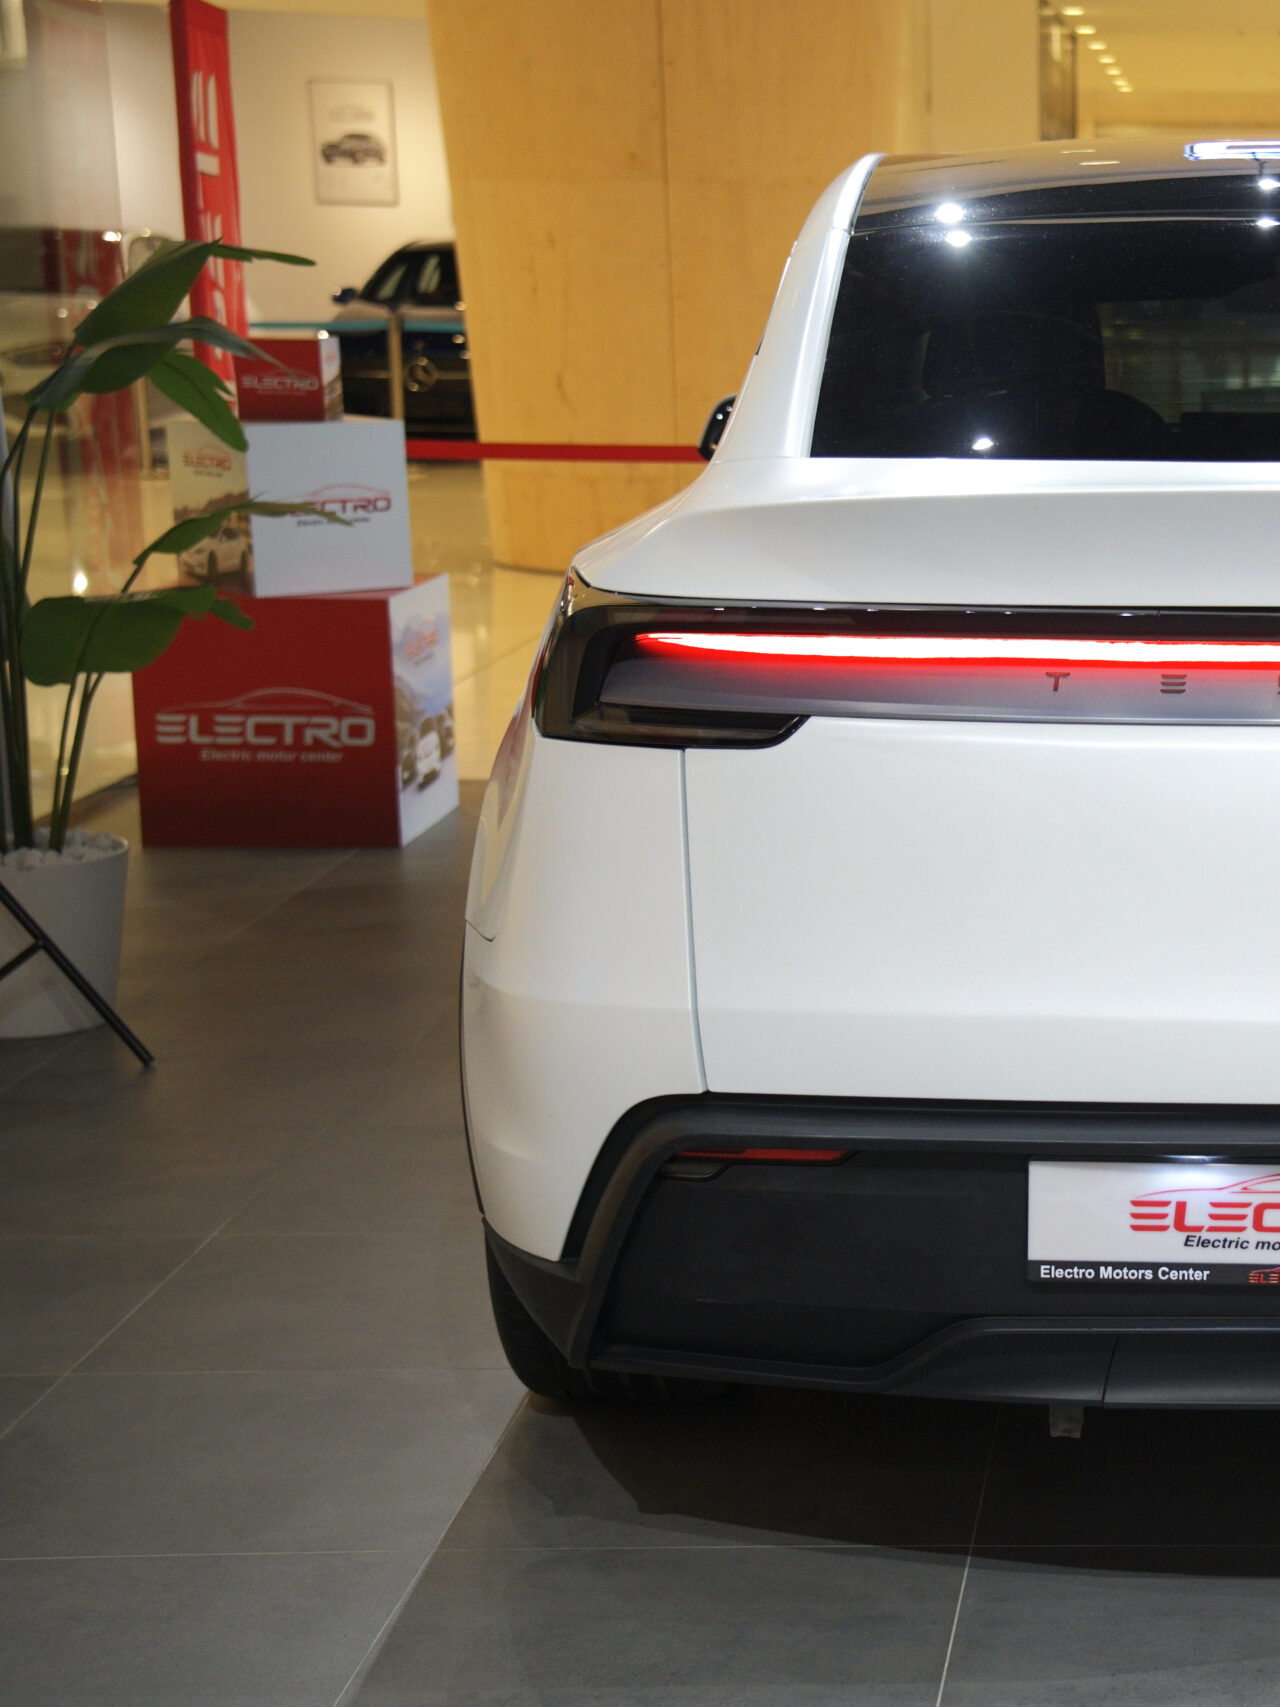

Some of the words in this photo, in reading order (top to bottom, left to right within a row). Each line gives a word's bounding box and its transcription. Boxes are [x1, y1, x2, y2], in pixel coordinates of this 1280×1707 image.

[242, 373, 319, 392] ELECTRO
[155, 713, 377, 748] ELECTRO
[201, 748, 253, 762] Electric
[256, 750, 297, 762] motor
[301, 750, 345, 762] center
[1183, 1235, 1250, 1250] Electric
[1040, 1265, 1096, 1280] Electro
[1099, 1266, 1153, 1280] Motors
[1158, 1267, 1210, 1281] Center
